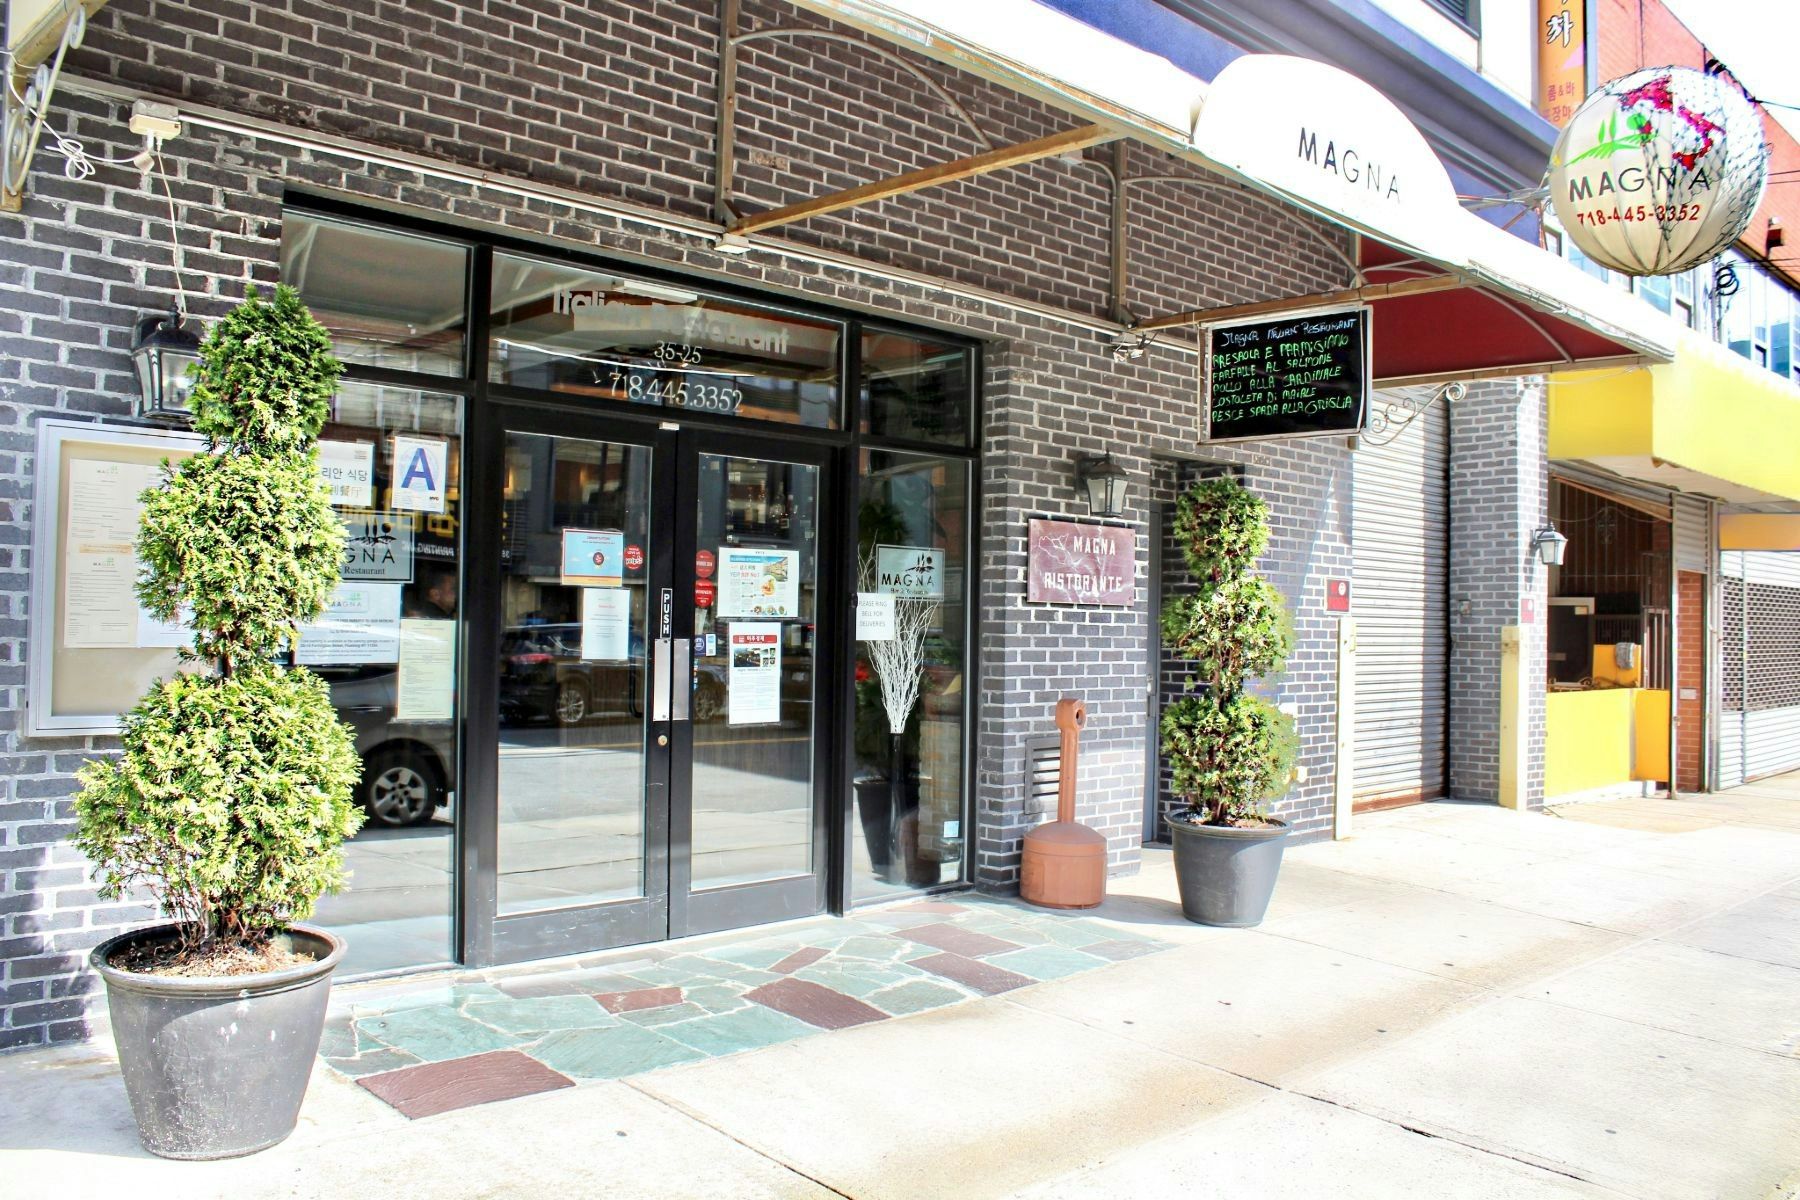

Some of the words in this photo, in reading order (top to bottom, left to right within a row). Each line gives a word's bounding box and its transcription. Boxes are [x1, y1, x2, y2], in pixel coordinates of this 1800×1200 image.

[1546, 9, 1574, 48] 차
[1298, 127, 1400, 204] MAGNA
[1569, 167, 1710, 203] MAGNA
[1577, 204, 1700, 226] 718-445-3352
[654, 340, 703, 365] 35-25
[1265, 347, 1274, 359] E
[1266, 361, 1281, 373] AL
[609, 372, 743, 413] 718.445.3352
[1213, 381, 1242, 395] POLLO
[1250, 376, 1275, 390] ALLA
[1212, 409, 1244, 423] PESCE
[1250, 404, 1278, 417] SPADA
[1282, 402, 1304, 414] ALLA
[321, 467, 343, 480] 리안
[347, 468, 369, 482] 식당
[401, 447, 436, 491] A
[344, 546, 395, 564] GNA
[1073, 535, 1116, 556] MAGNA
[344, 565, 386, 575] Restaurant
[881, 573, 935, 587] MAGNA
[1044, 572, 1123, 593] RISTORANTE
[662, 593, 671, 634] PUSH
